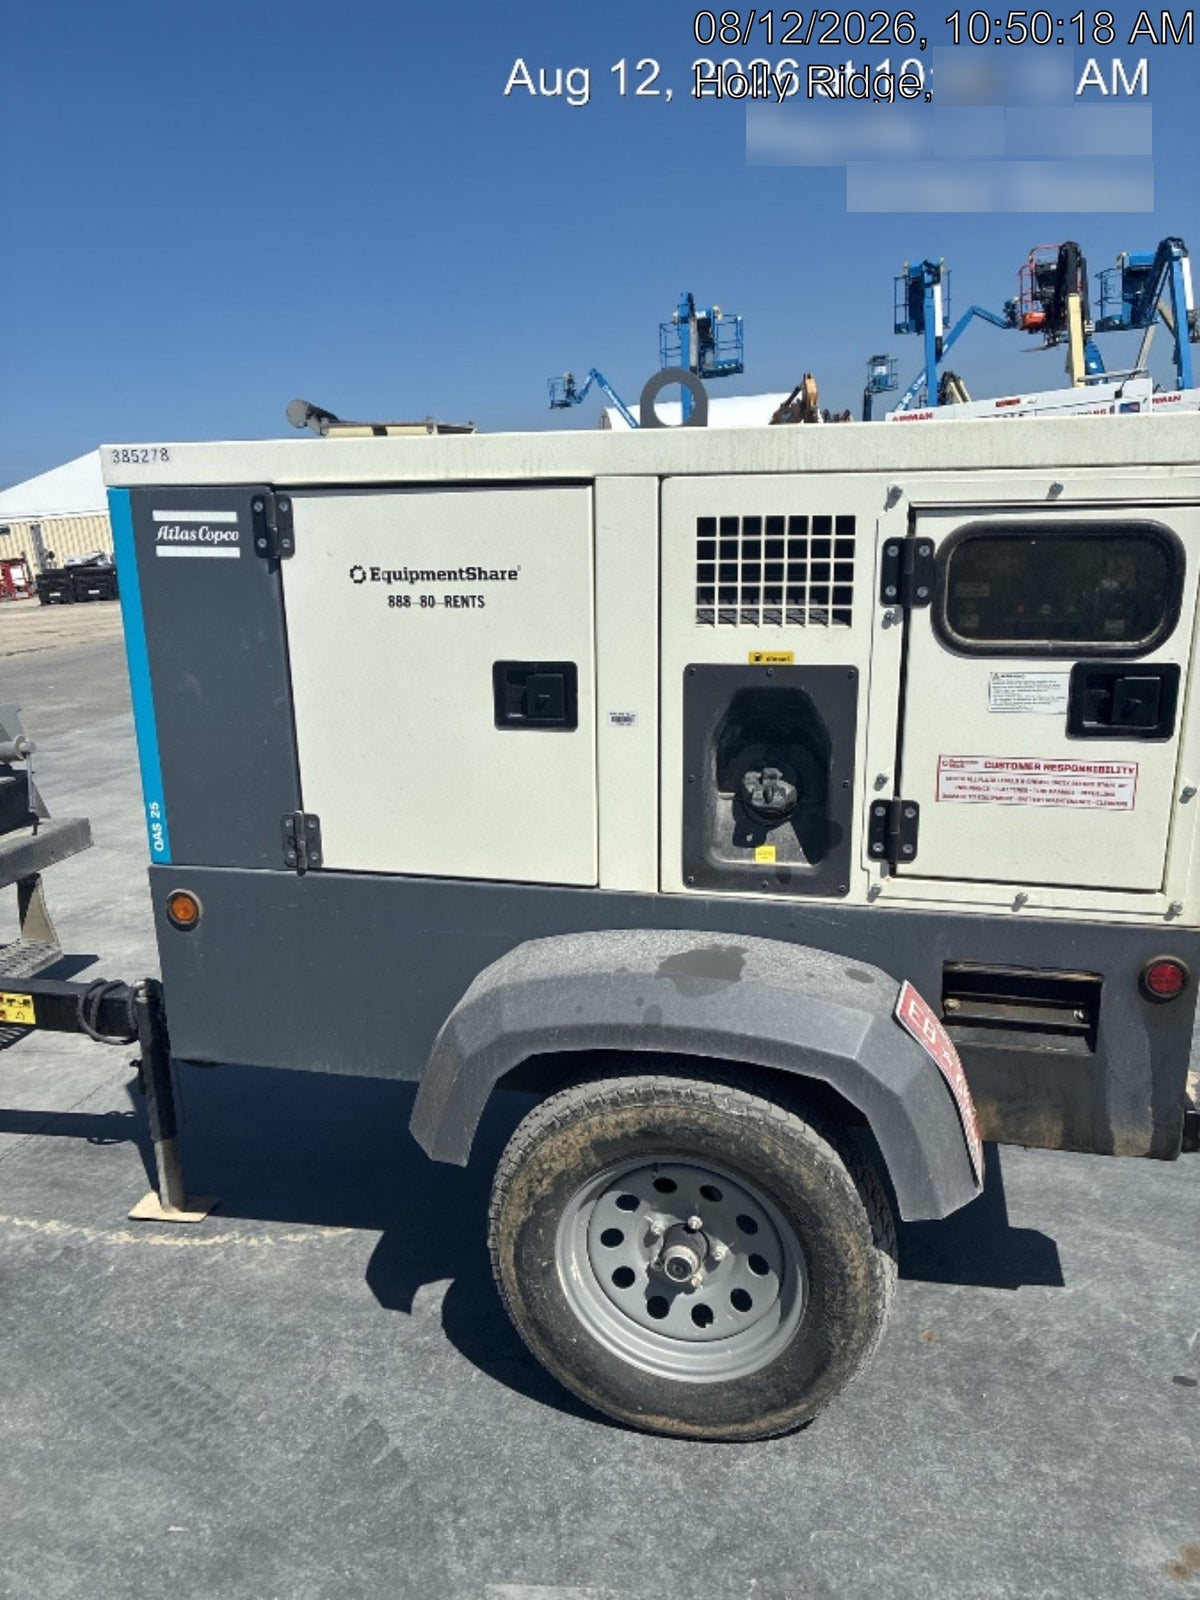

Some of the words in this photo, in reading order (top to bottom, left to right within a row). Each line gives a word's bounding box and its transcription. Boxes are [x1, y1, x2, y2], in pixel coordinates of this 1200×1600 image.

[112, 448, 169, 463] 385278
[156, 526, 197, 541] Atlas
[199, 526, 239, 544] Copco
[369, 566, 519, 584] EquipmentShare
[984, 761, 1041, 770] CUSTOMER
[1043, 763, 1135, 774] RESPONSIBILITY
